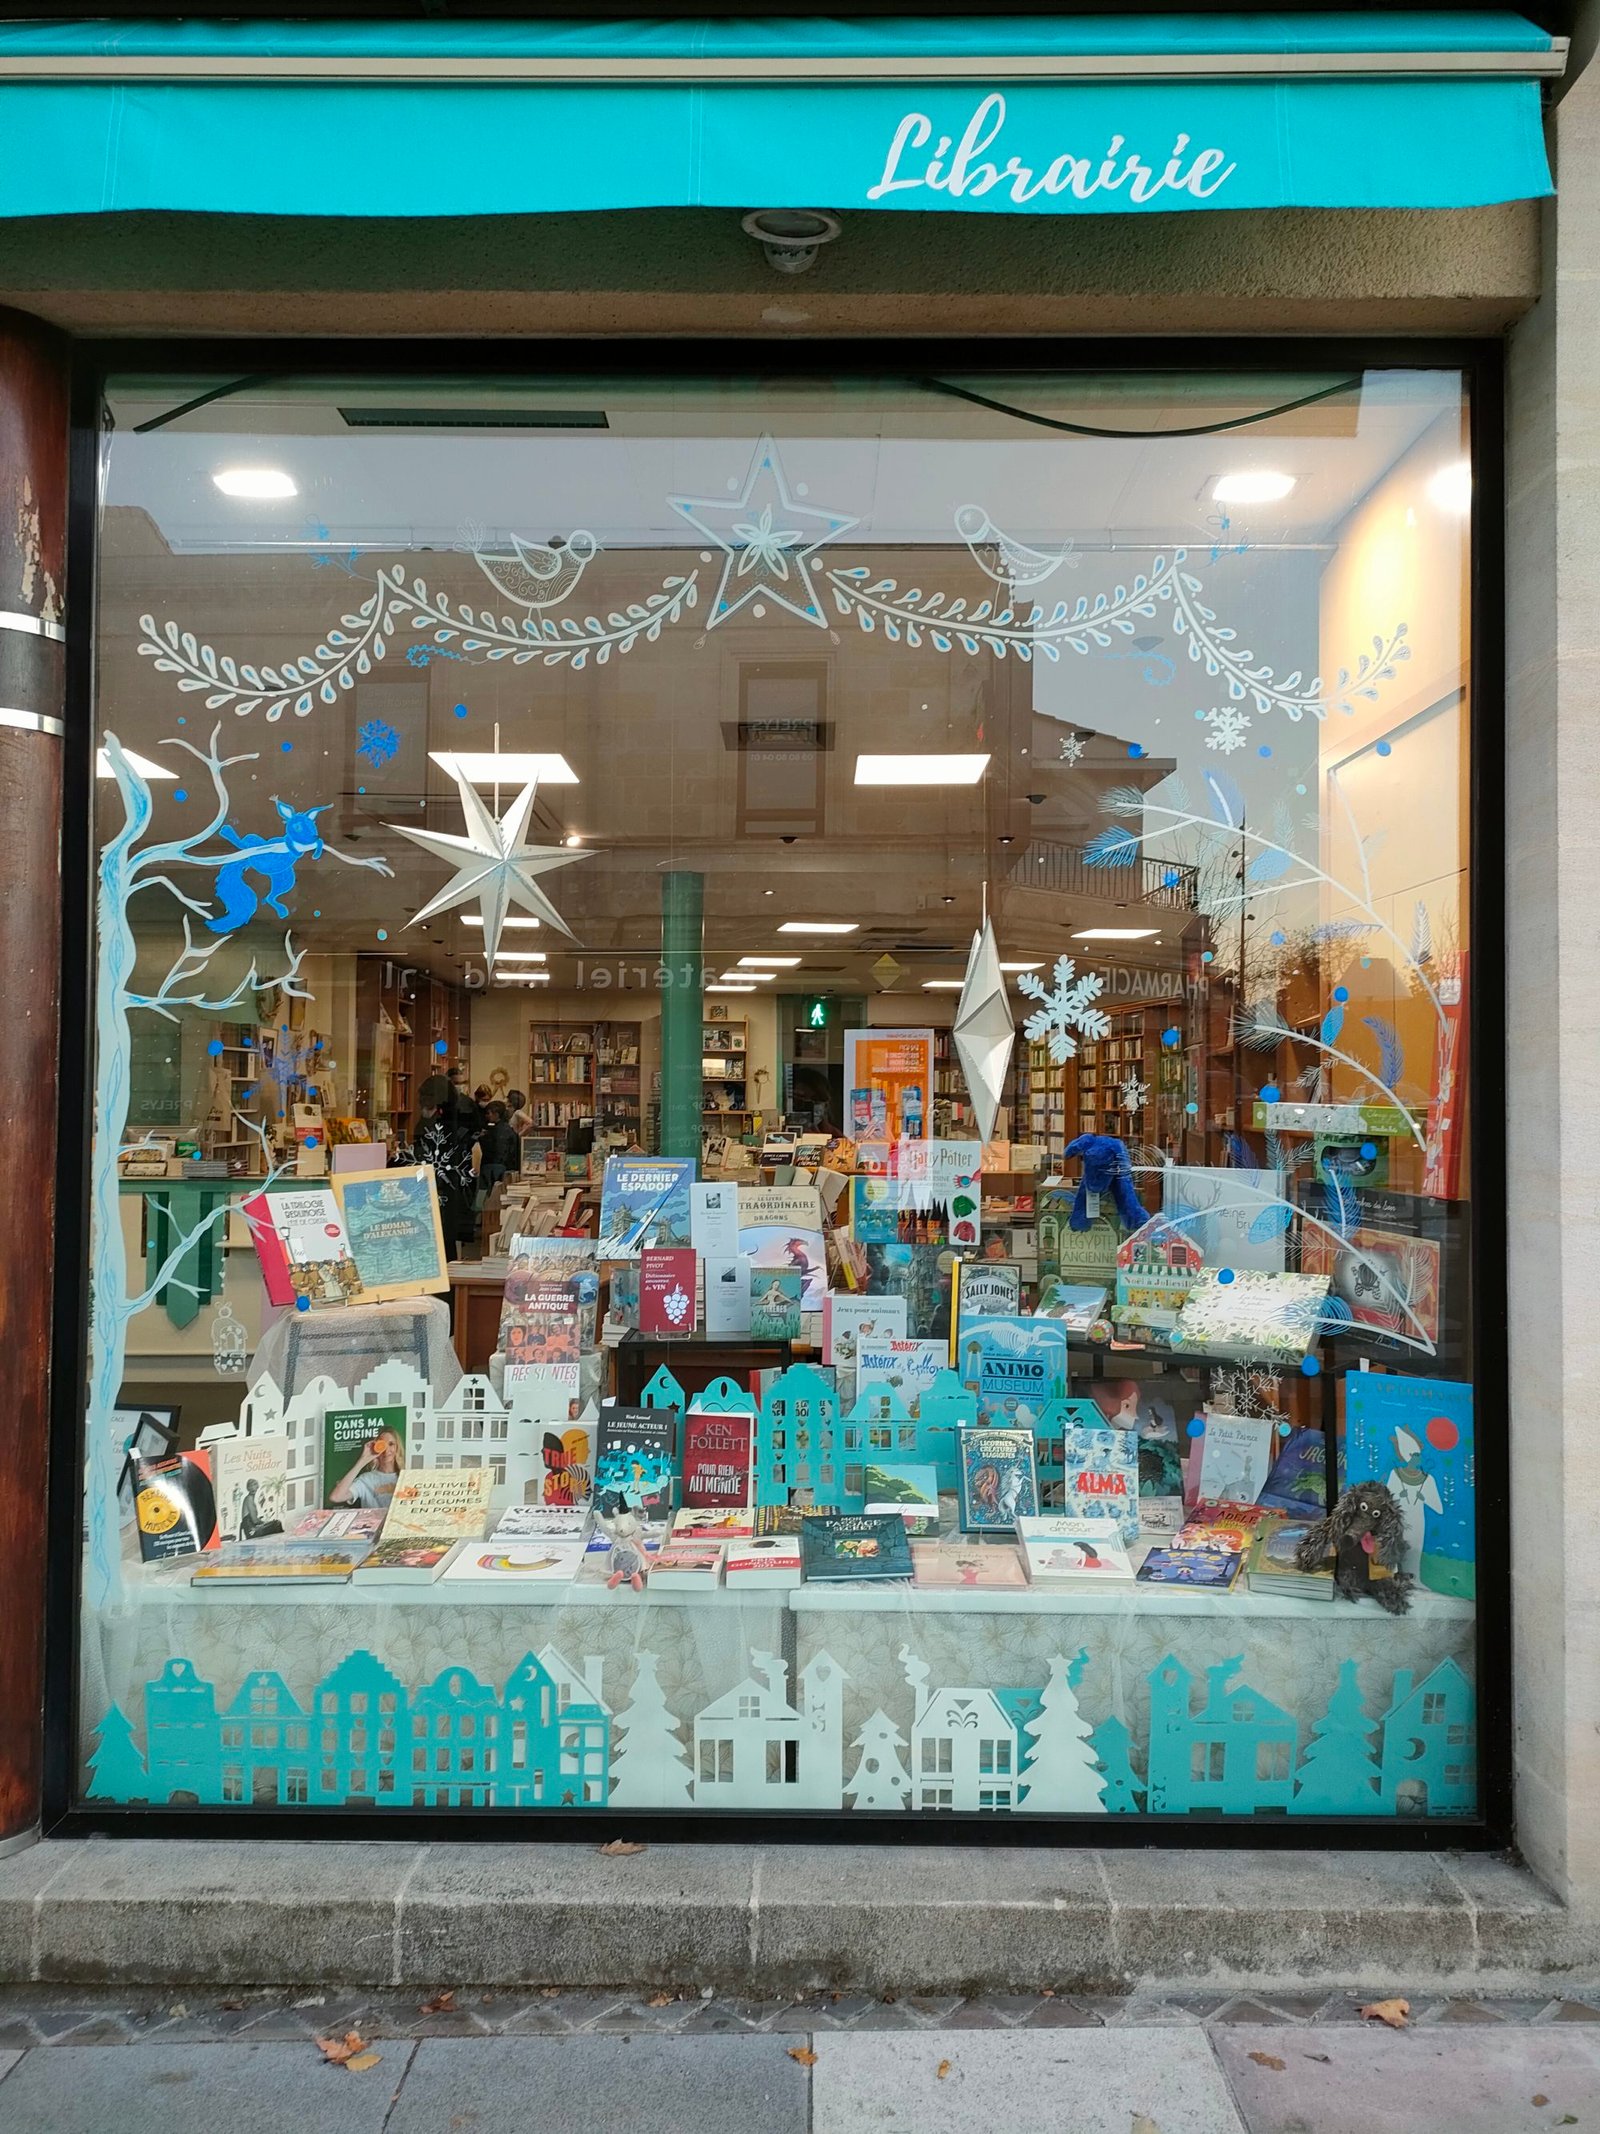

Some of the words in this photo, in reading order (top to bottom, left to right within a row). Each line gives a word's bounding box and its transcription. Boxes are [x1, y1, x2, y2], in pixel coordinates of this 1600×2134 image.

[866, 92, 1237, 202] Librairie
[940, 1148, 972, 1168] Potter
[617, 1174, 628, 1182] LE
[631, 1173, 679, 1182] DERNIER
[281, 1202, 290, 1210] LA
[739, 1201, 816, 1210] TRAORDINAIRE
[381, 1220, 411, 1230] ROMAN
[524, 1293, 536, 1302] LA
[538, 1294, 575, 1302] GUERRE
[965, 1283, 988, 1300] SALLY
[990, 1284, 1014, 1302] JONES
[528, 1302, 569, 1311] ANTIQUE
[890, 1340, 924, 1352] Astérix
[861, 1353, 898, 1369] Astérix
[982, 1361, 1044, 1377] ANIMO
[982, 1378, 1045, 1392] MUSEUM
[334, 1418, 365, 1430] DANS
[368, 1417, 384, 1428] MA
[616, 1421, 637, 1429] JEUNE
[704, 1423, 733, 1436] KEN
[334, 1427, 379, 1441] CUISINE
[1218, 1428, 1233, 1439] Petit
[1235, 1430, 1258, 1442] Prince
[690, 1435, 747, 1452] FOLLETT
[224, 1453, 241, 1465] Les
[243, 1449, 272, 1462] Nuits
[544, 1447, 577, 1466] TRUE
[246, 1459, 282, 1473] Solidor
[697, 1463, 717, 1475] POUR
[718, 1464, 734, 1476] RIEN
[413, 1481, 477, 1489] CULTIVER
[544, 1472, 592, 1498] STORY
[688, 1476, 704, 1493] AU
[705, 1476, 741, 1495] MONDE
[1077, 1472, 1127, 1495] ALMA
[433, 1489, 480, 1497] FRUITS
